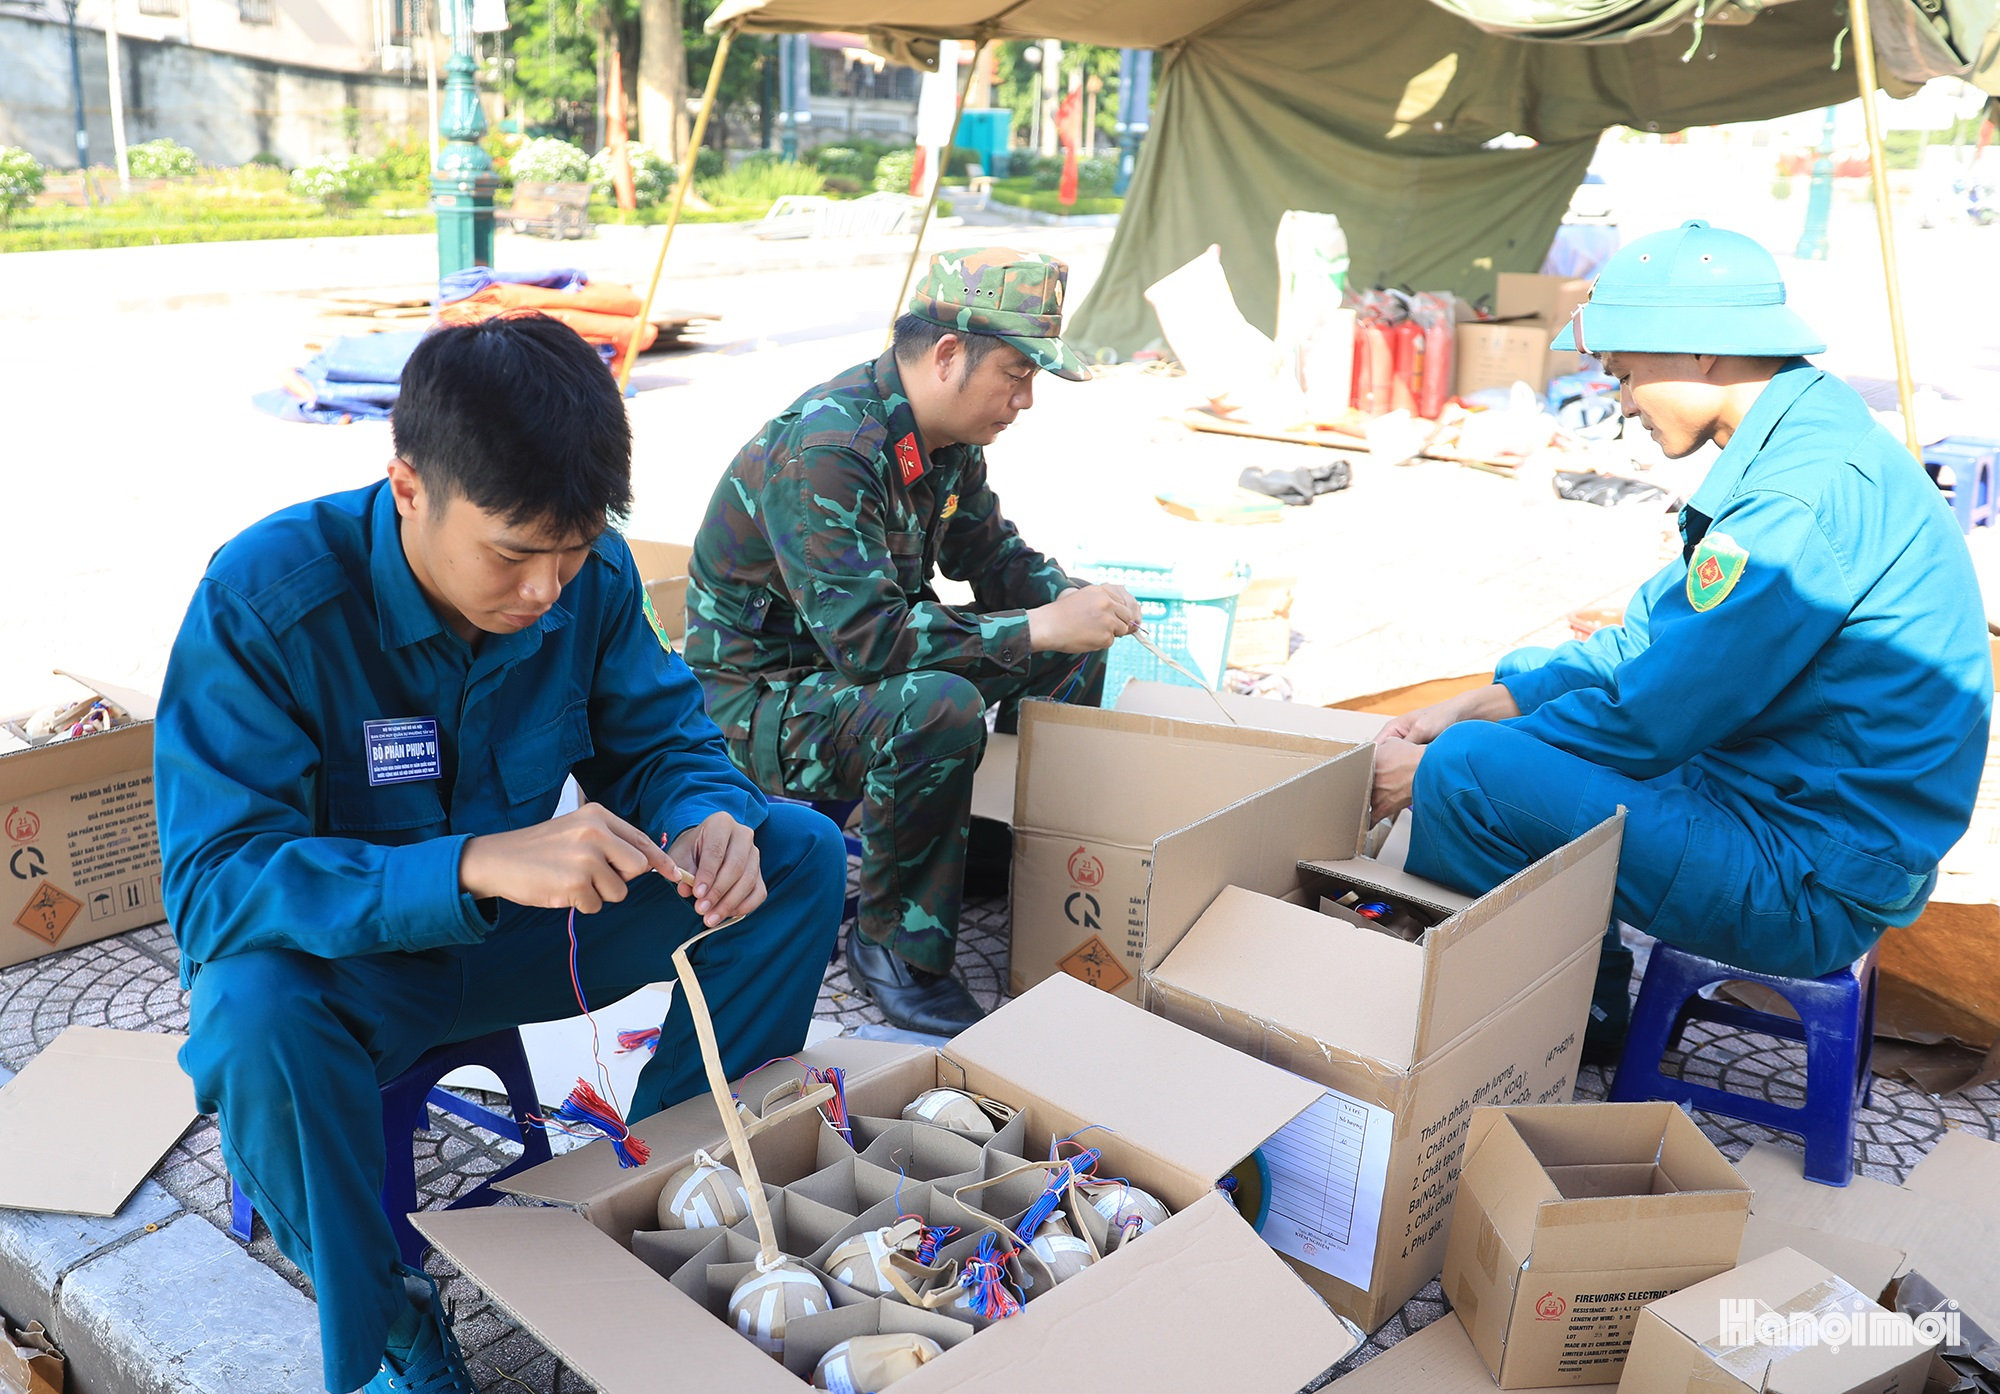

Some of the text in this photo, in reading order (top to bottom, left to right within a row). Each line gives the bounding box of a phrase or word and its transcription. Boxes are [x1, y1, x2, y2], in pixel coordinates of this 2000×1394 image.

[372, 741, 435, 763] BỘ PHẬN PHỤC VỤ
[71, 791, 88, 802] PHÁO
[89, 788, 101, 798] HOA
[103, 784, 112, 794] NỔ
[128, 780, 140, 788] CAO
[1086, 967, 1102, 978] 1.1
[1420, 1115, 1447, 1143] Thành
[1447, 1100, 1470, 1126] phần,
[1472, 1082, 1490, 1105] định
[1490, 1063, 1516, 1090] lượng:
[1416, 1152, 1423, 1166] 1.
[1426, 1135, 1446, 1160] Chất
[1446, 1127, 1460, 1144] oxi
[1460, 1115, 1472, 1133] hó
[1412, 1176, 1419, 1192] 2.
[1422, 1158, 1442, 1182] Chất
[1443, 1150, 1456, 1168] tạo
[1405, 1223, 1412, 1238] 3.
[1414, 1203, 1434, 1230] Chất
[1401, 1218, 1444, 1260] 4. Phụ gia:
[1574, 1292, 1626, 1303] FIREWORKS
[1627, 1290, 1668, 1302] ELECTRIC
